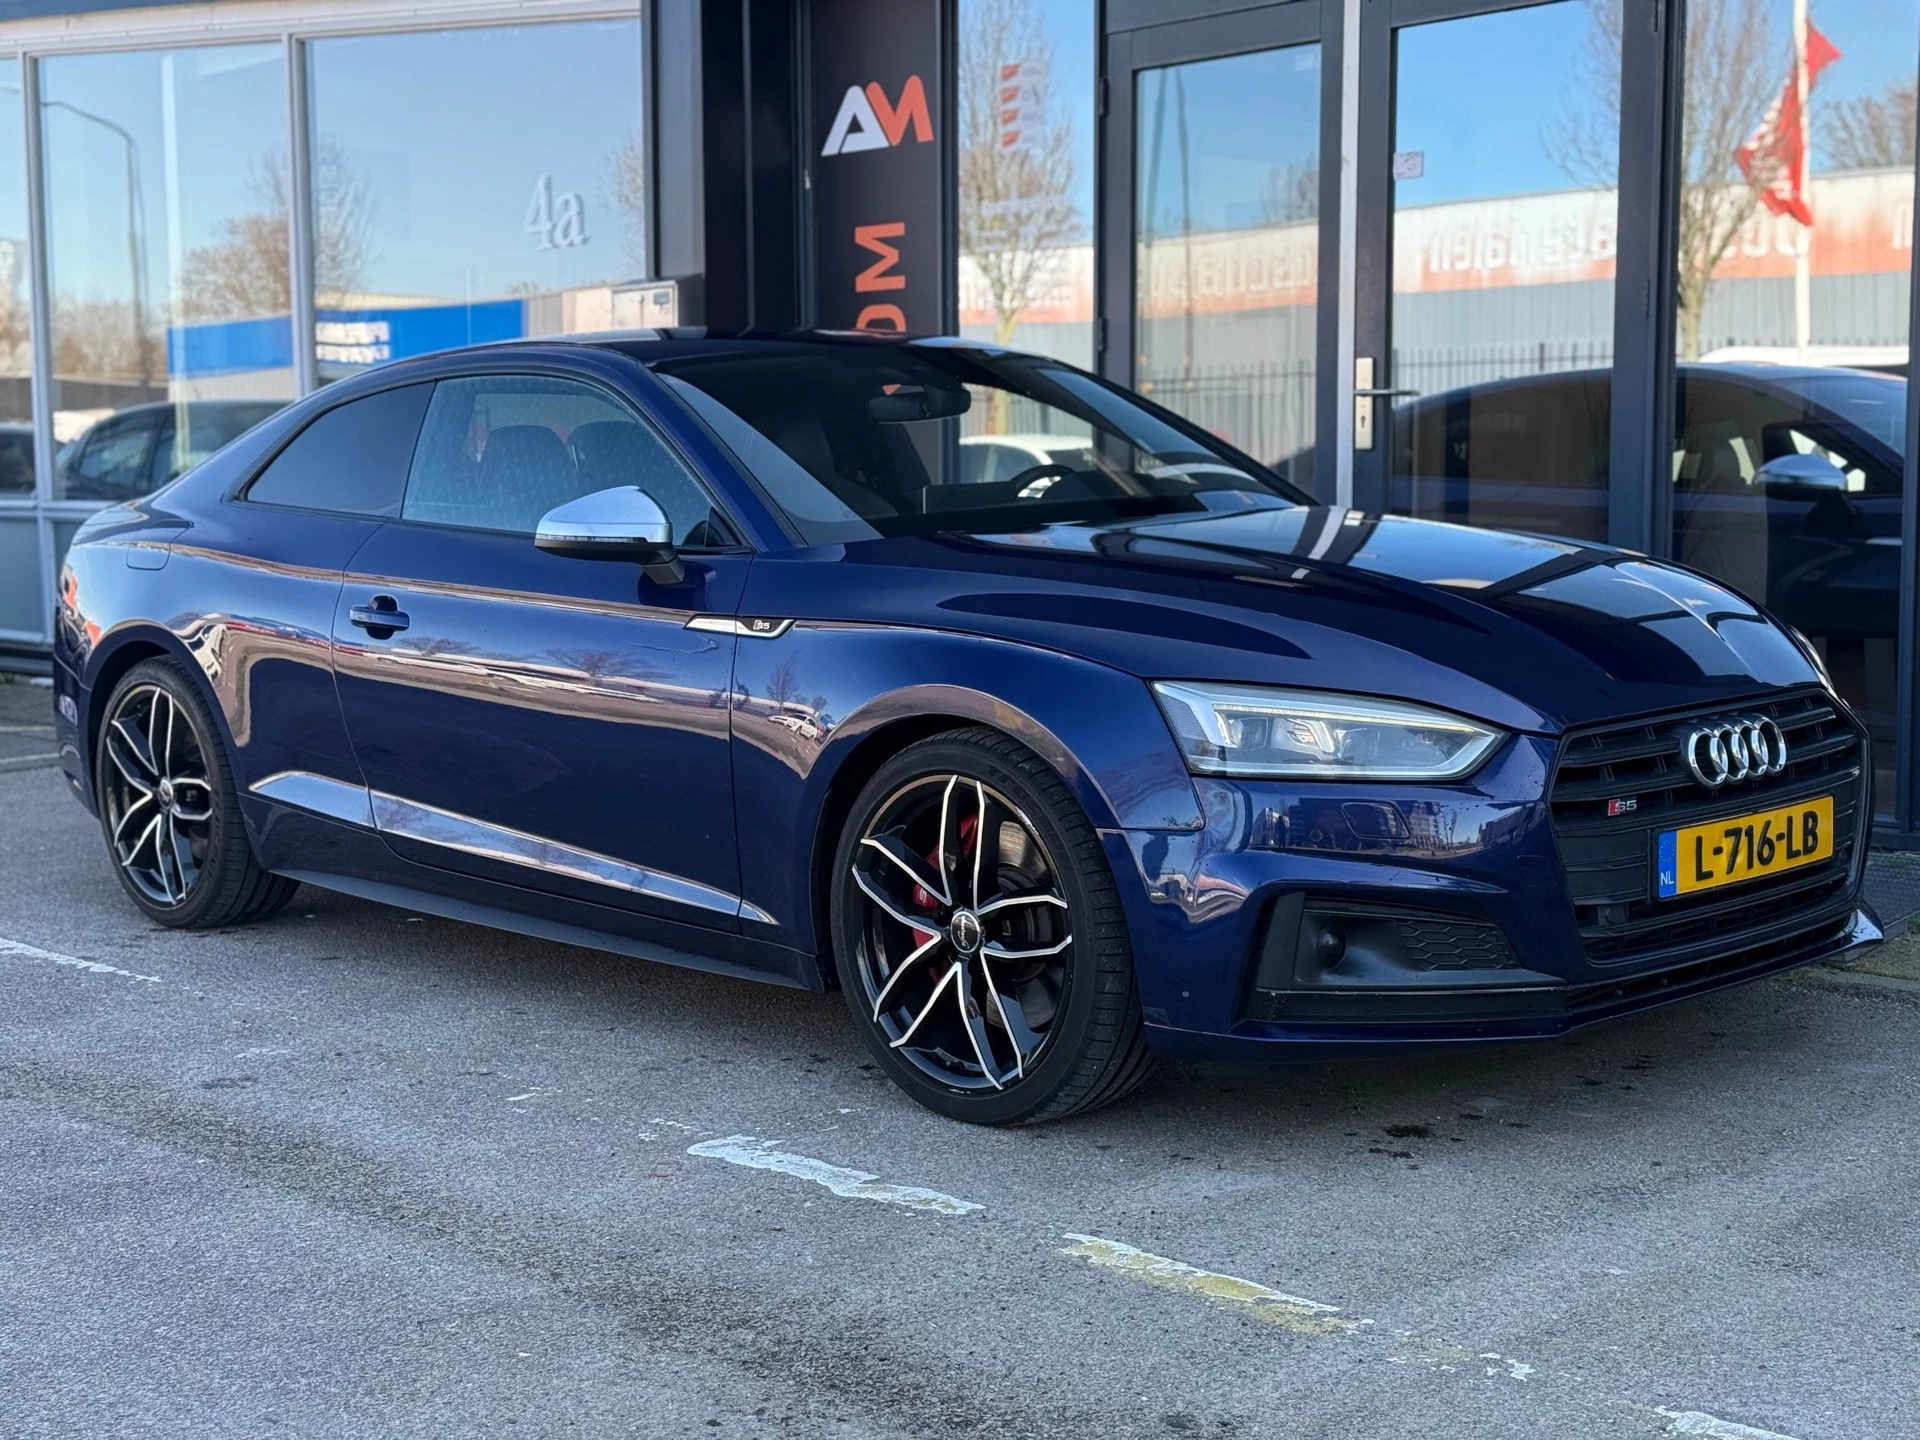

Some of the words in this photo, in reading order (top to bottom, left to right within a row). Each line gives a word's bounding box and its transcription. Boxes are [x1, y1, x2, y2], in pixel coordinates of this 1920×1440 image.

[821, 74, 934, 157] AM
[523, 172, 587, 251] 4a
[1611, 799, 1637, 814] S5
[1660, 872, 1674, 886] NL
[1695, 810, 1819, 882] L-716-LB
